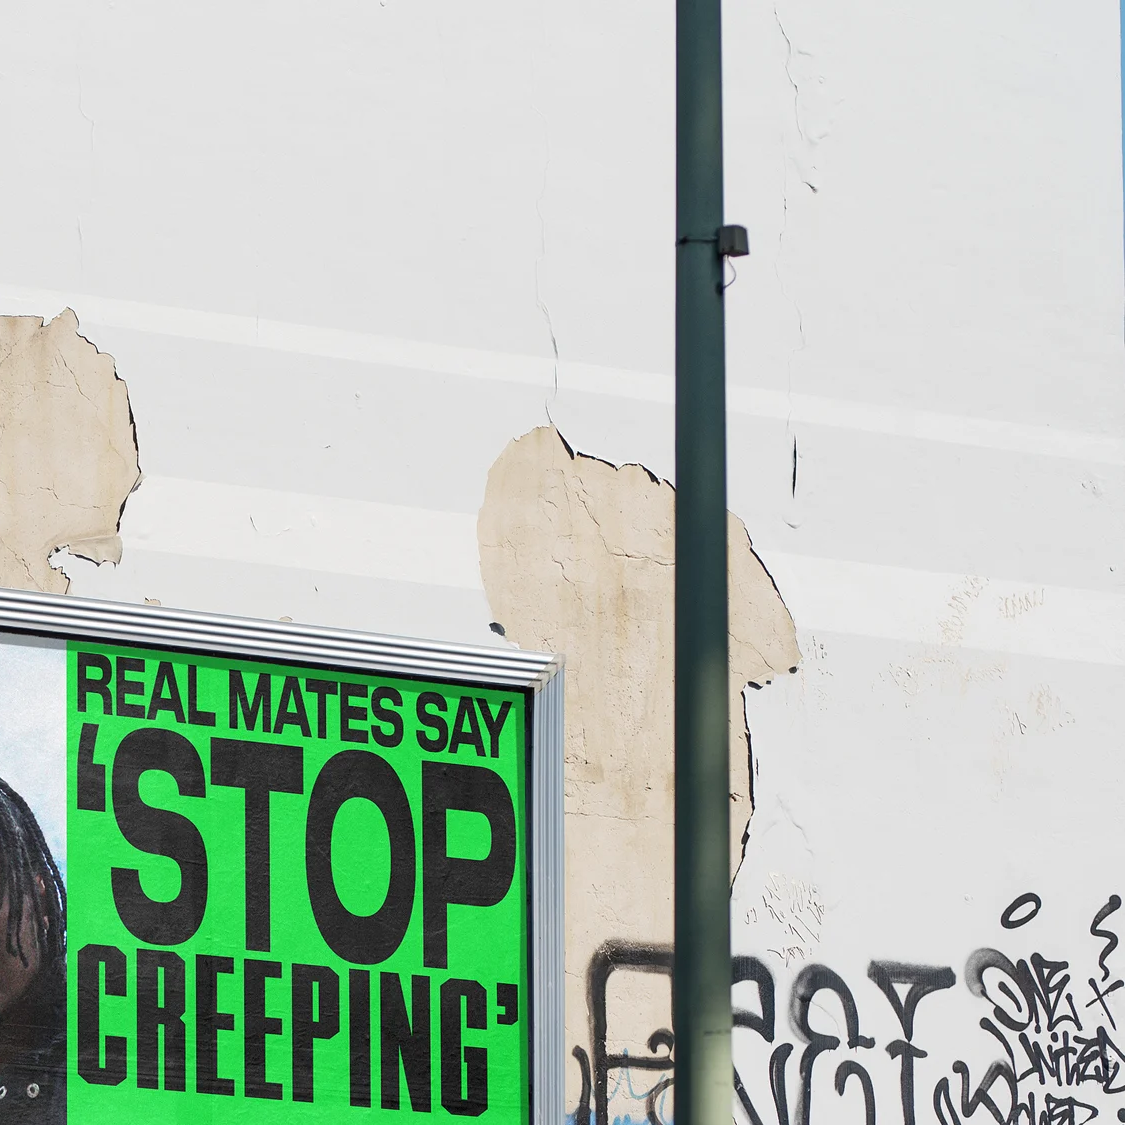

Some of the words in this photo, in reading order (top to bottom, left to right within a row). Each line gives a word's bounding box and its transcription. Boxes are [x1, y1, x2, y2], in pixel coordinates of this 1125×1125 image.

[76, 651, 217, 728] REAL
[228, 668, 404, 749] MATES
[415, 690, 514, 759] SAY
